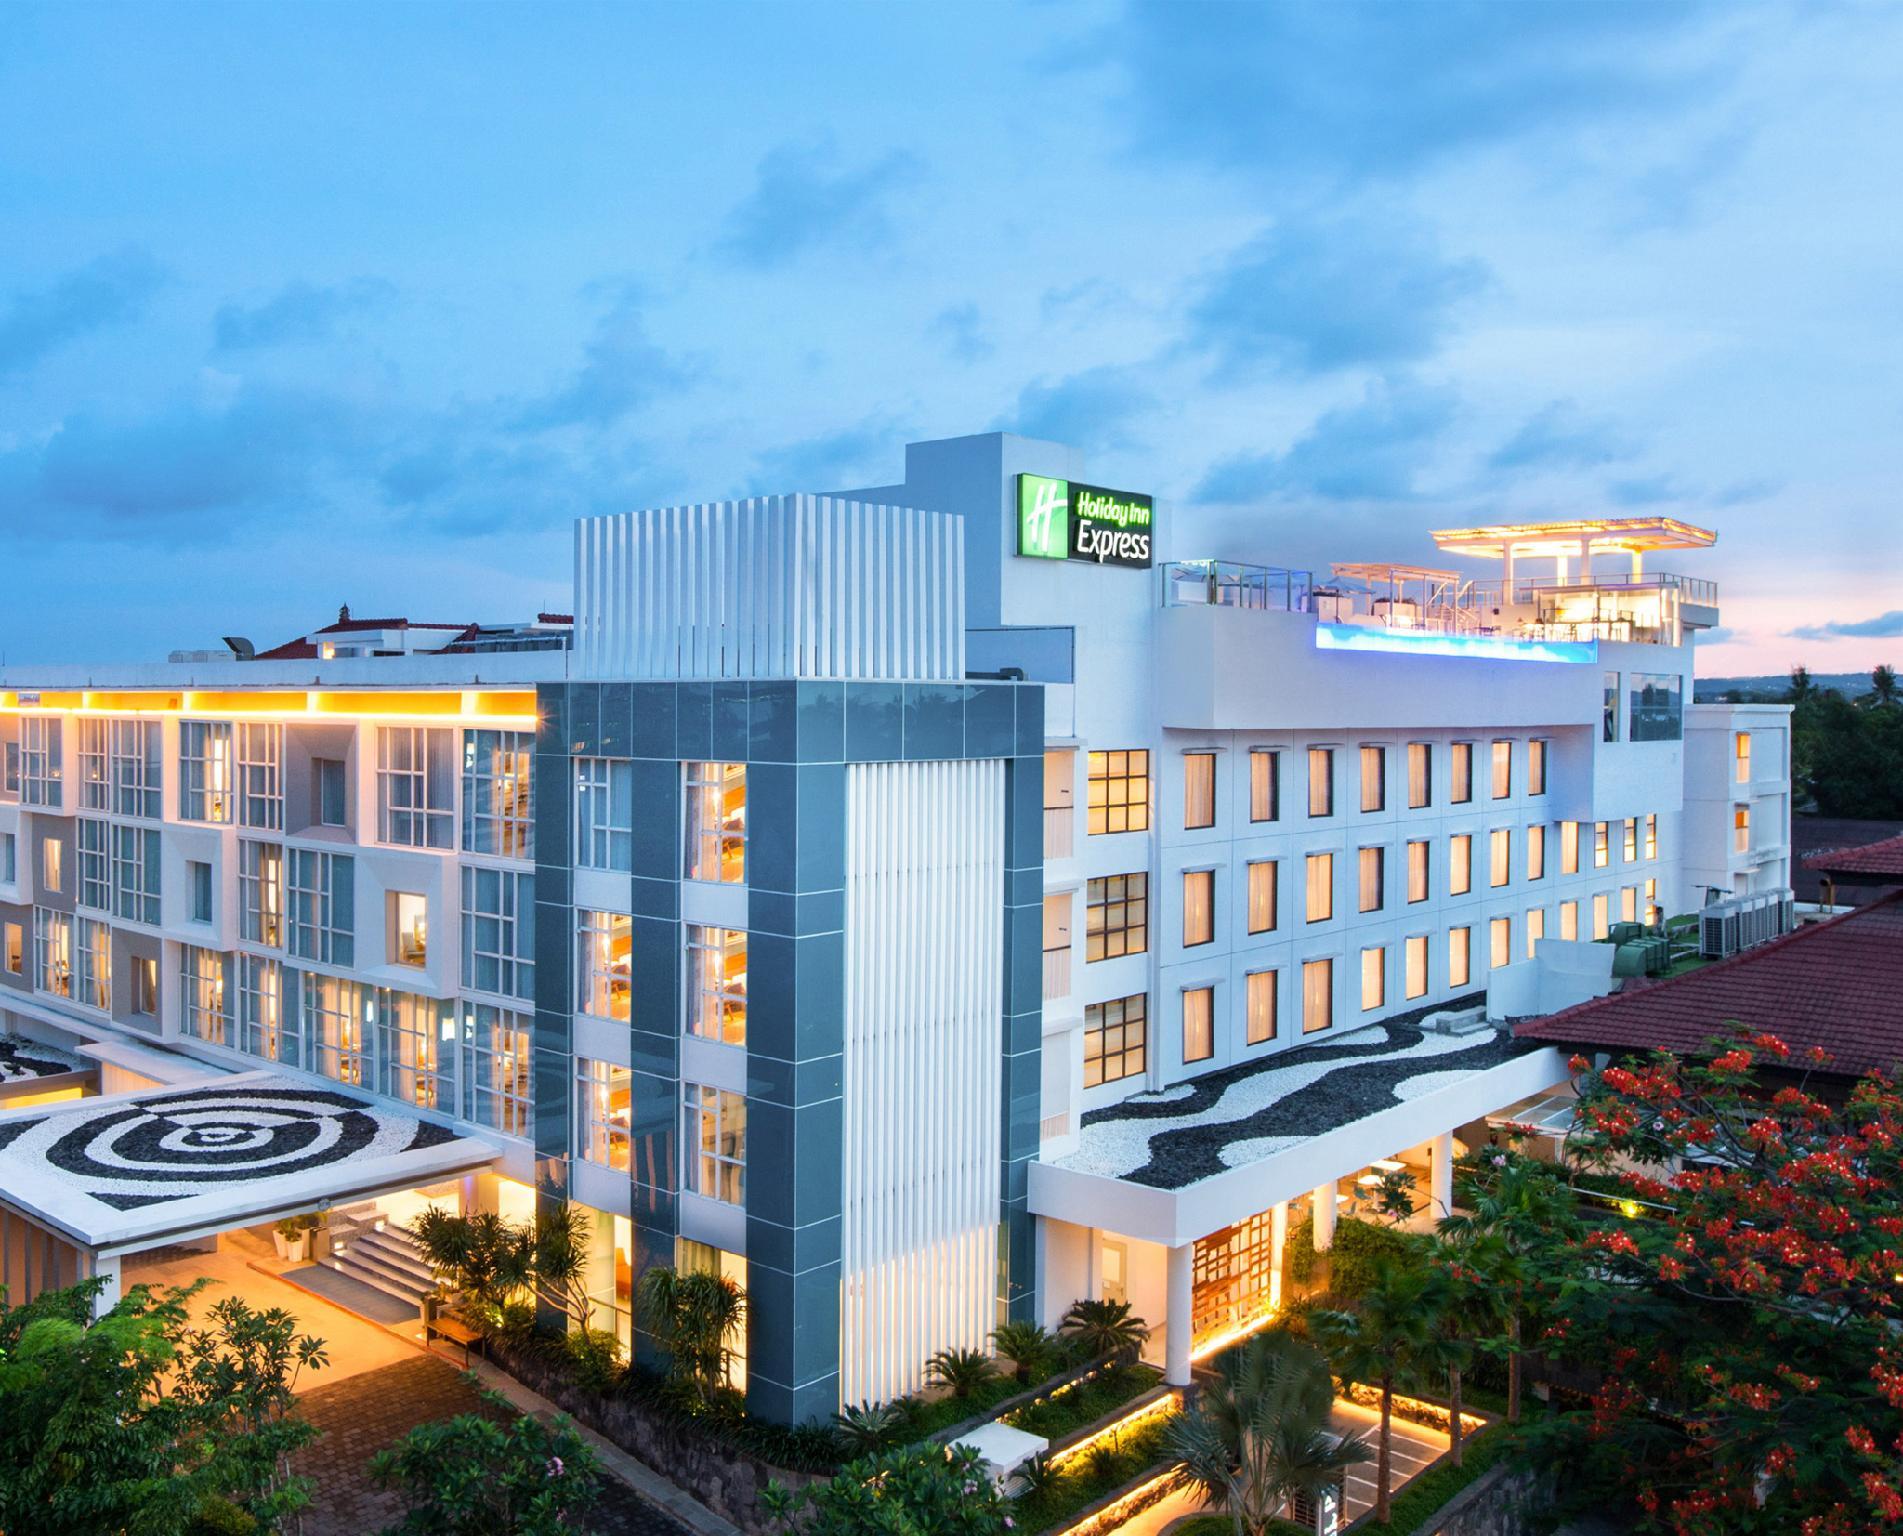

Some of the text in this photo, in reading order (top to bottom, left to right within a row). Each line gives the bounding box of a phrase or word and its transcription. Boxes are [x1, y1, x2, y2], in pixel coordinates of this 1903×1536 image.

[1077, 491, 1149, 527] Holiday Inn
[1077, 519, 1149, 564] Express
